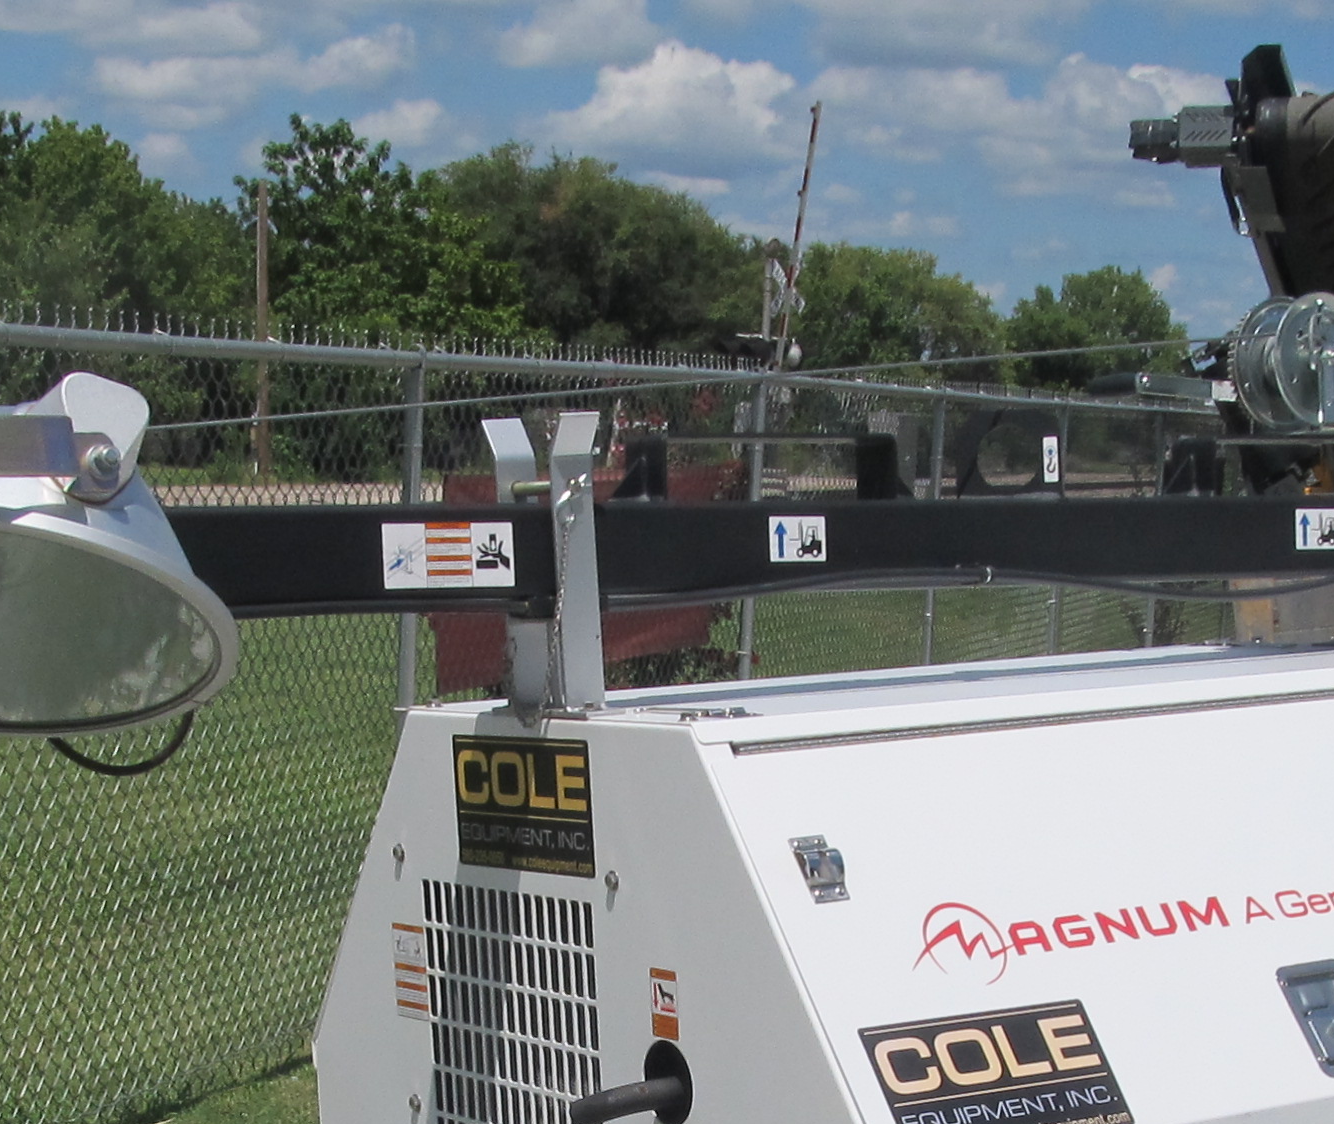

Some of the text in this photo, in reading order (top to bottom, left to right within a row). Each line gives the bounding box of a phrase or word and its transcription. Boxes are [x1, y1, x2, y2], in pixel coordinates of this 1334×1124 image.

[457, 749, 588, 812] COLE
[557, 831, 590, 851] INC.
[1245, 896, 1275, 924] A
[874, 1014, 1102, 1095] COLE
[1067, 1085, 1119, 1108] INC.
